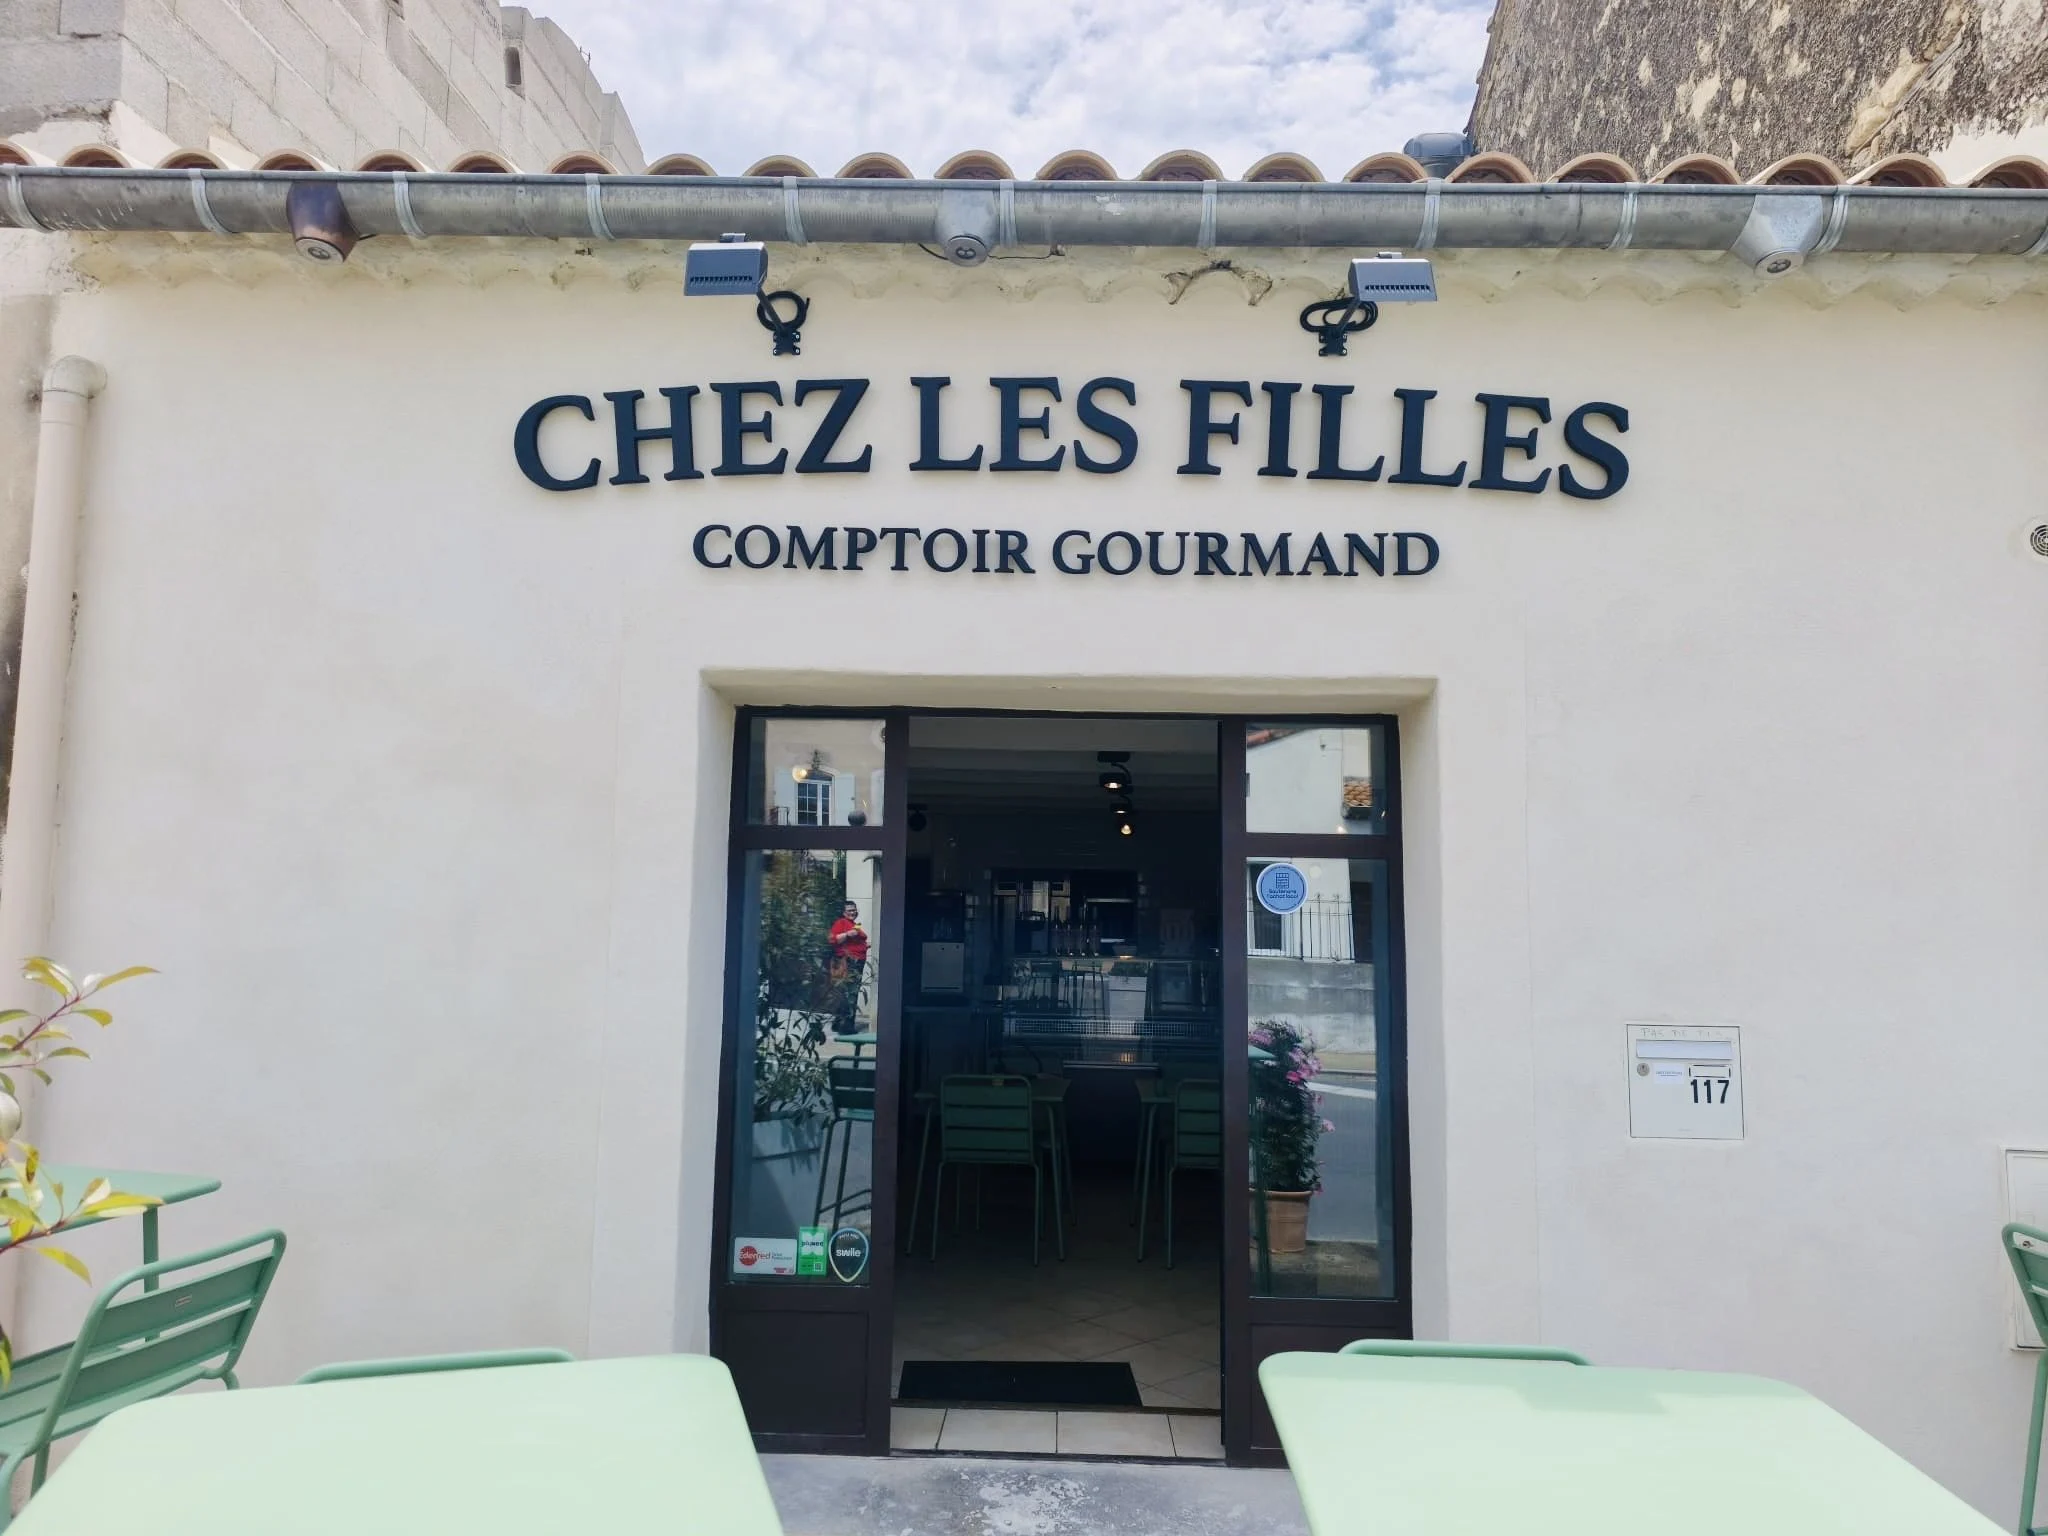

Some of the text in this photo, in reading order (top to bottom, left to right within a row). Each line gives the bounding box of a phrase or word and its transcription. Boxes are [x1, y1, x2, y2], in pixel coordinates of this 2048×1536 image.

[513, 376, 1631, 501] CHEZ LES FILLES
[692, 524, 1441, 578] COMPTOIR GOURMAND
[1690, 1078, 1731, 1104] 117
[739, 1250, 771, 1260] Edenred
[836, 1248, 861, 1257] swile
